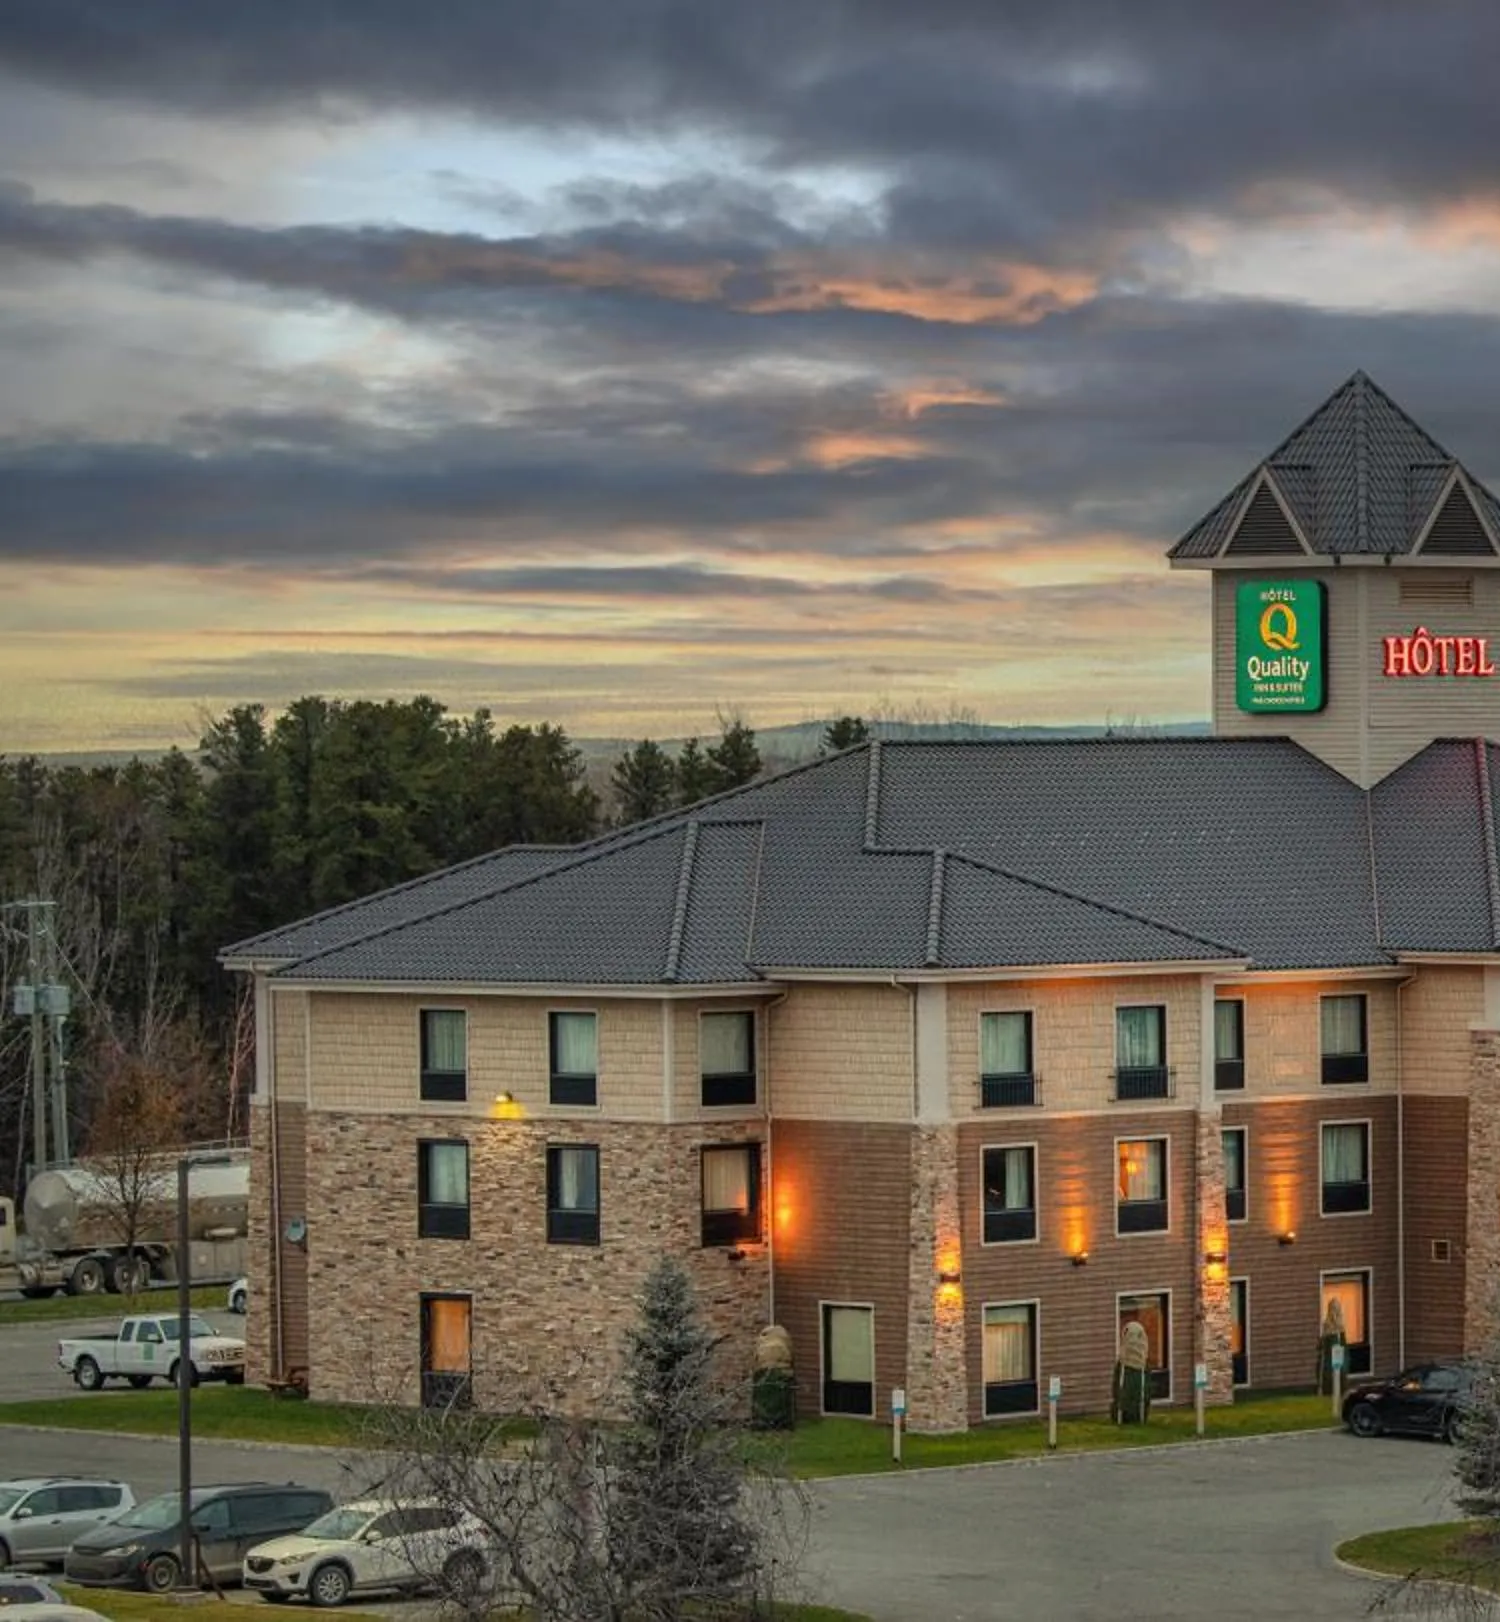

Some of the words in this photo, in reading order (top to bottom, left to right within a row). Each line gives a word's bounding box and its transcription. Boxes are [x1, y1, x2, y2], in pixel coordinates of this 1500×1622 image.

[1260, 603, 1301, 650] Q
[1247, 655, 1310, 681] Quality
[1384, 626, 1496, 676] HÔTEL
